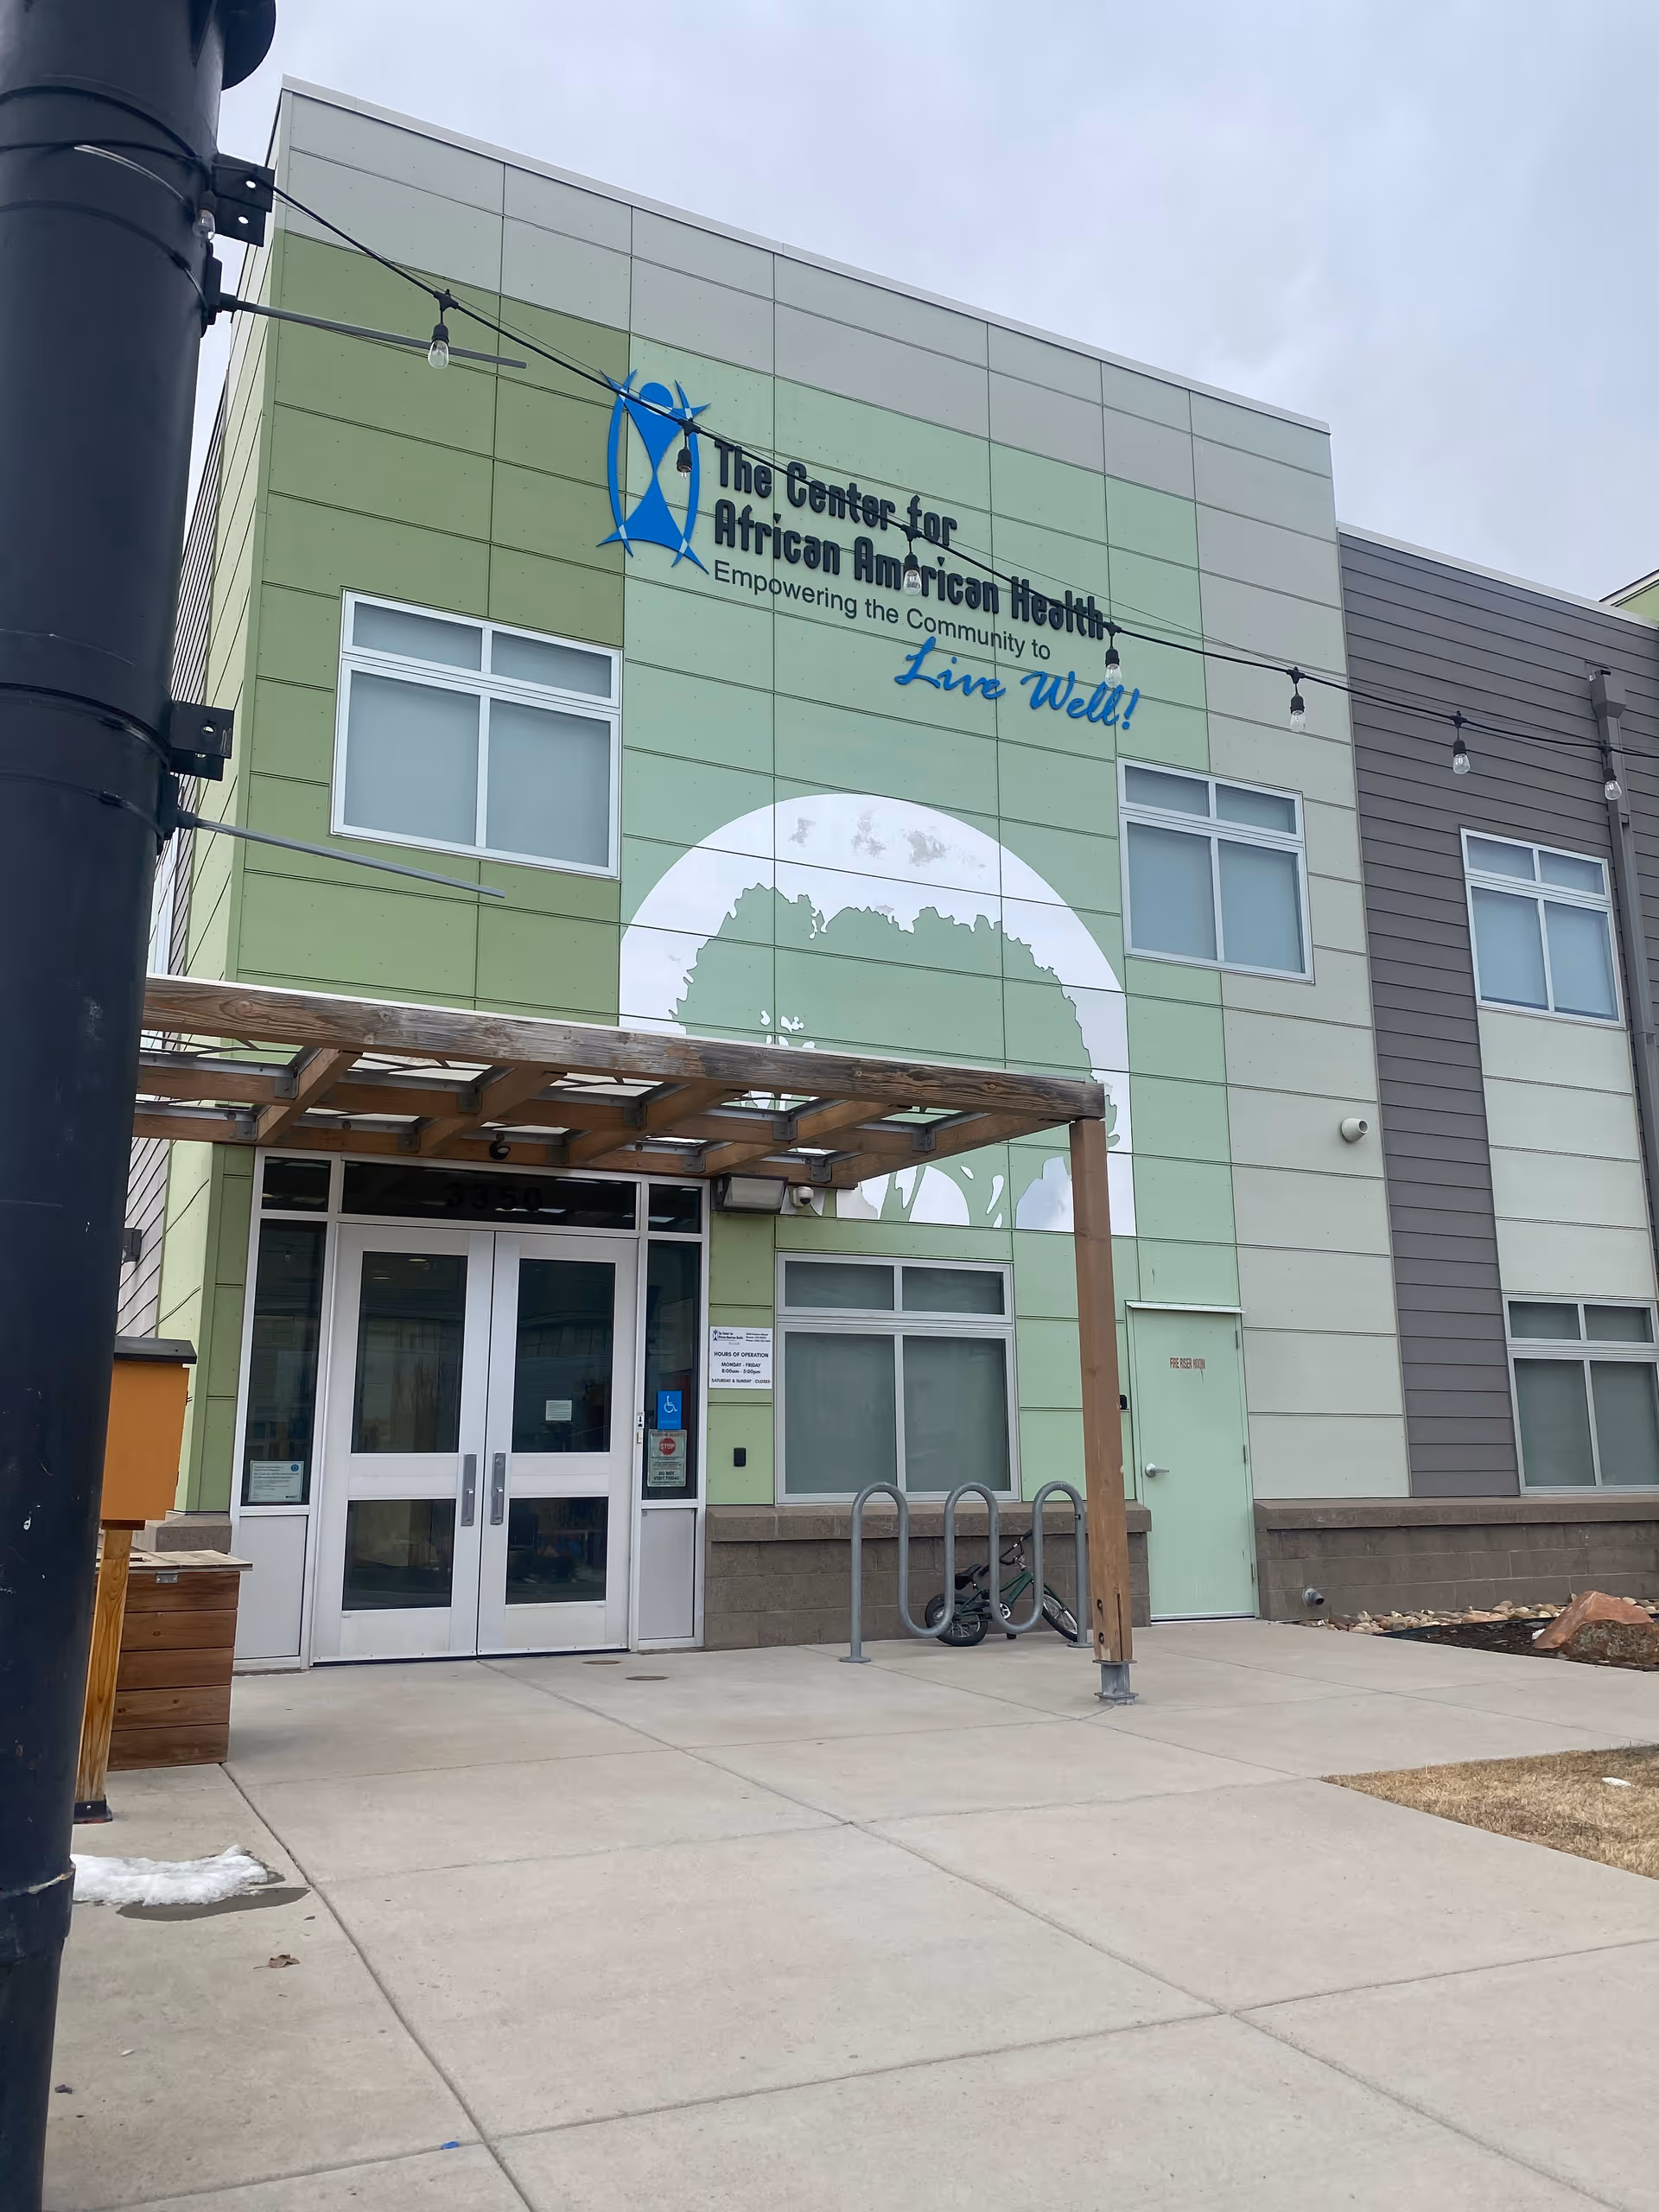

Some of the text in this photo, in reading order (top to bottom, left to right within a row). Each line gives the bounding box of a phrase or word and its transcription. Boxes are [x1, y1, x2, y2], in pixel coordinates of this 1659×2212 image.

[715, 440, 957, 547] The Center for
[715, 499, 1104, 640] African Amrican Health
[715, 559, 1051, 660] Empowering the Community to
[894, 636, 1141, 730] Live Well!
[443, 1181, 543, 1212] 3350
[1170, 1357, 1206, 1369] FIRE RISER ROOM
